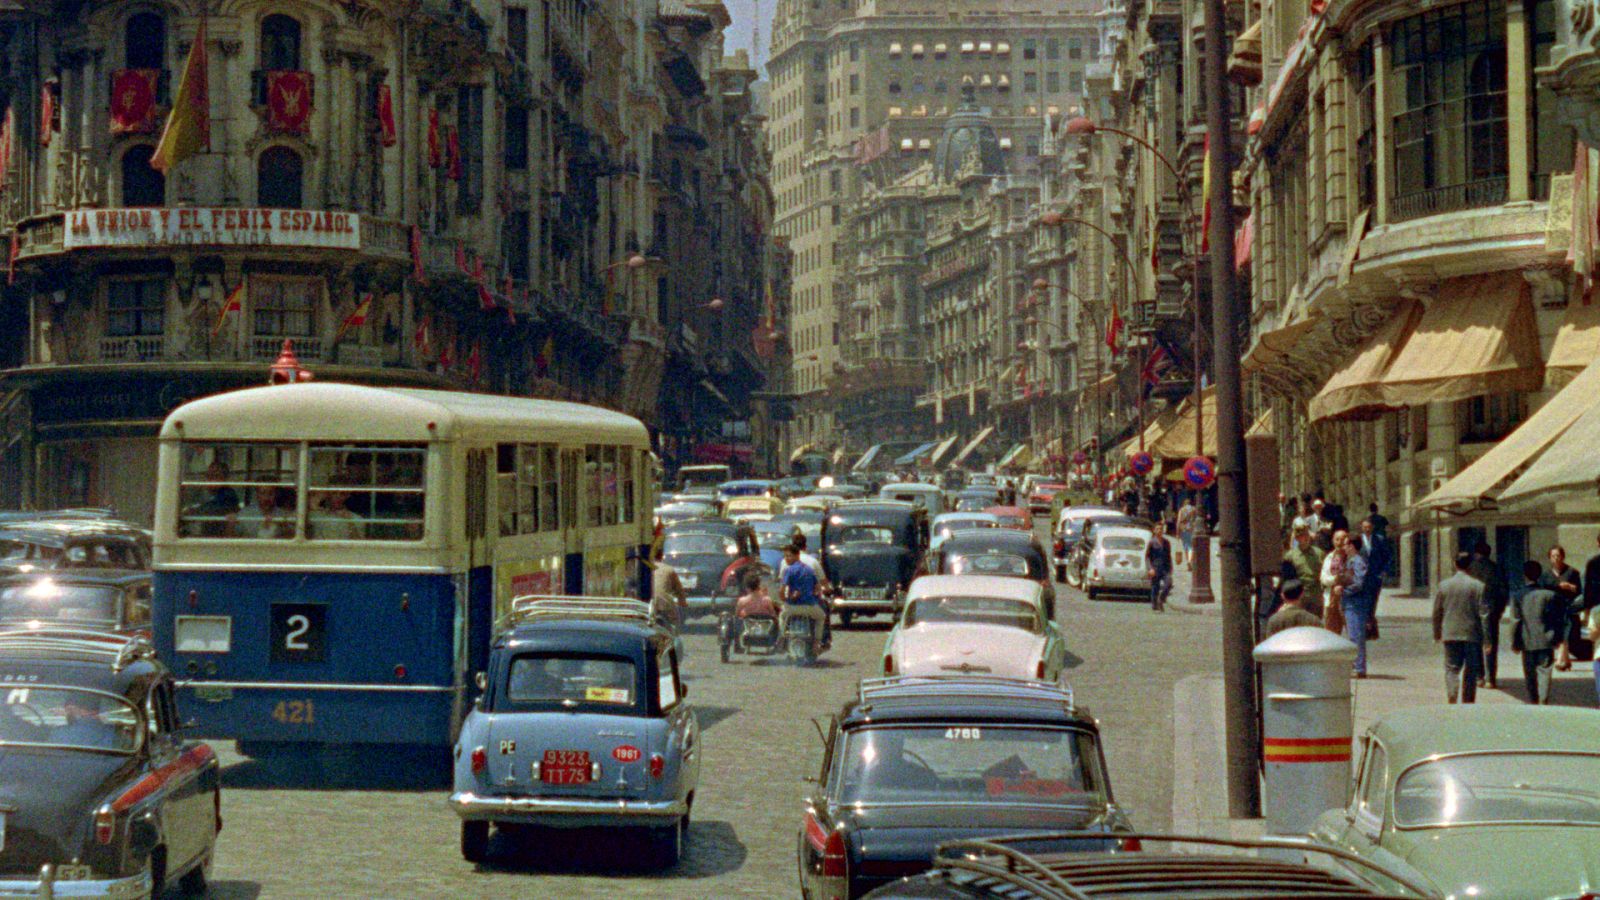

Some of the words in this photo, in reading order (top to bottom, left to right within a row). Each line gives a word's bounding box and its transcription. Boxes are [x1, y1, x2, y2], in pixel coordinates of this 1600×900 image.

[71, 212, 90, 236] LA
[96, 210, 151, 232] UNION
[160, 210, 171, 228] Y
[179, 209, 203, 228] EL
[211, 209, 272, 230] FENIX
[286, 614, 310, 650] 2
[272, 699, 314, 724] 421
[499, 740, 515, 754] PE
[616, 748, 638, 760] 1961
[547, 751, 586, 766] 9323
